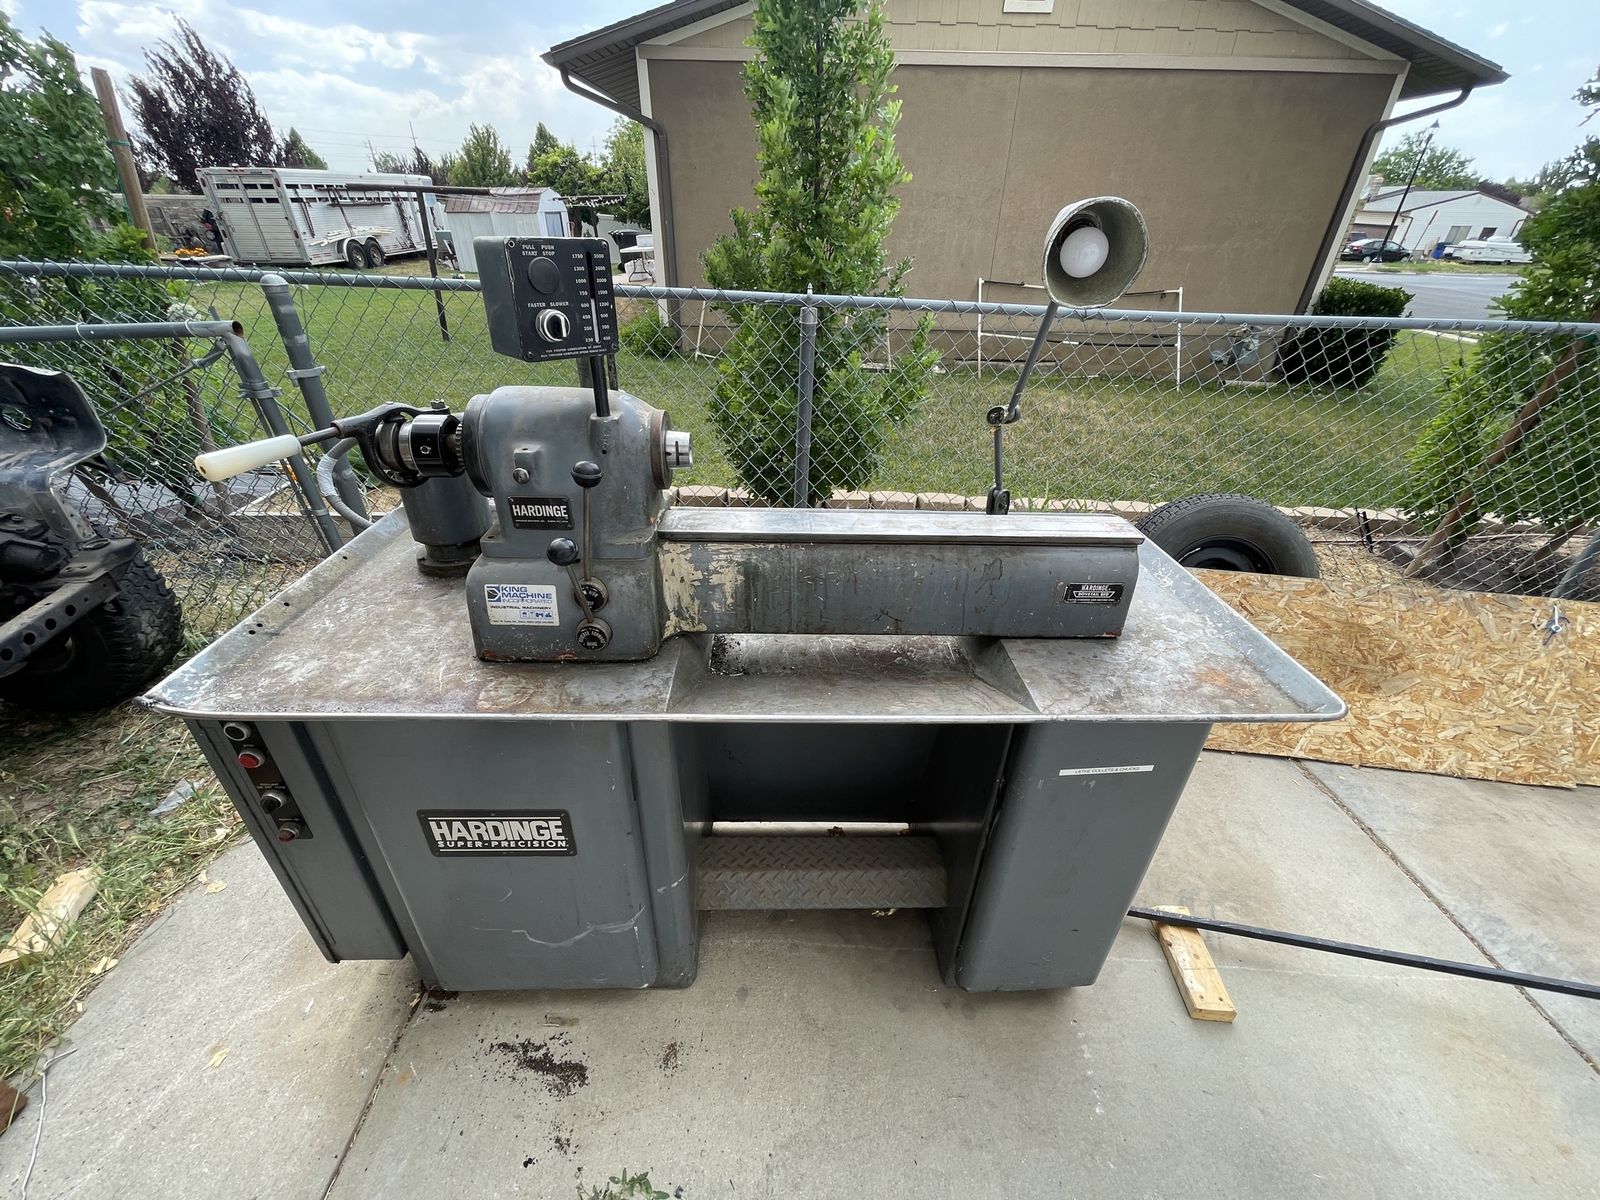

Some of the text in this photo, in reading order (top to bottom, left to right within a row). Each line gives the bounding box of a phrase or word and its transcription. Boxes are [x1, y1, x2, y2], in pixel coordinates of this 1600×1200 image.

[512, 504, 568, 517] HARDINGE
[429, 820, 566, 841] HARDINGE
[437, 840, 568, 848] SUPER-PRECISION
